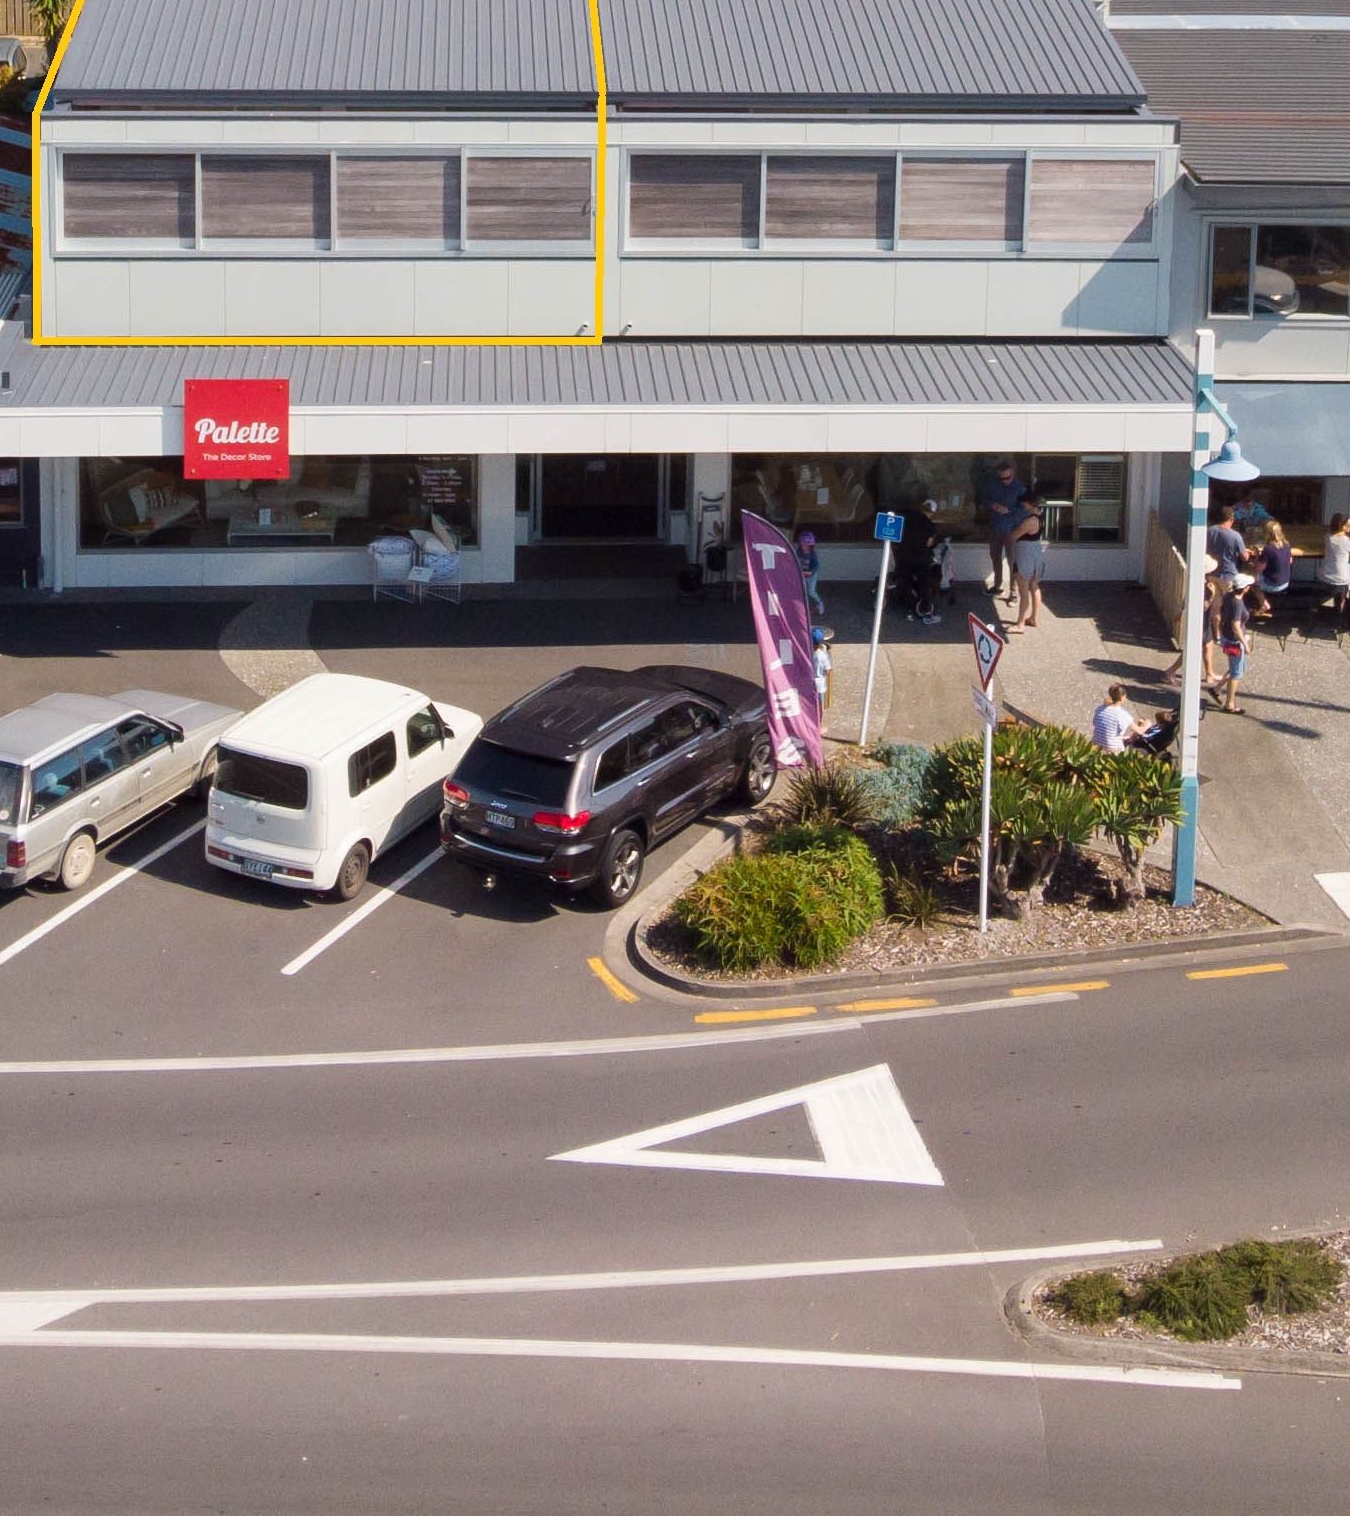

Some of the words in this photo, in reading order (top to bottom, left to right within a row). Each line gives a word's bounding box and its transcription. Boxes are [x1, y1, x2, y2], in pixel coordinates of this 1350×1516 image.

[194, 418, 280, 444] Palette
[202, 453, 218, 461] The
[221, 453, 246, 461] Decor
[249, 453, 272, 461] Store
[886, 516, 896, 526] P
